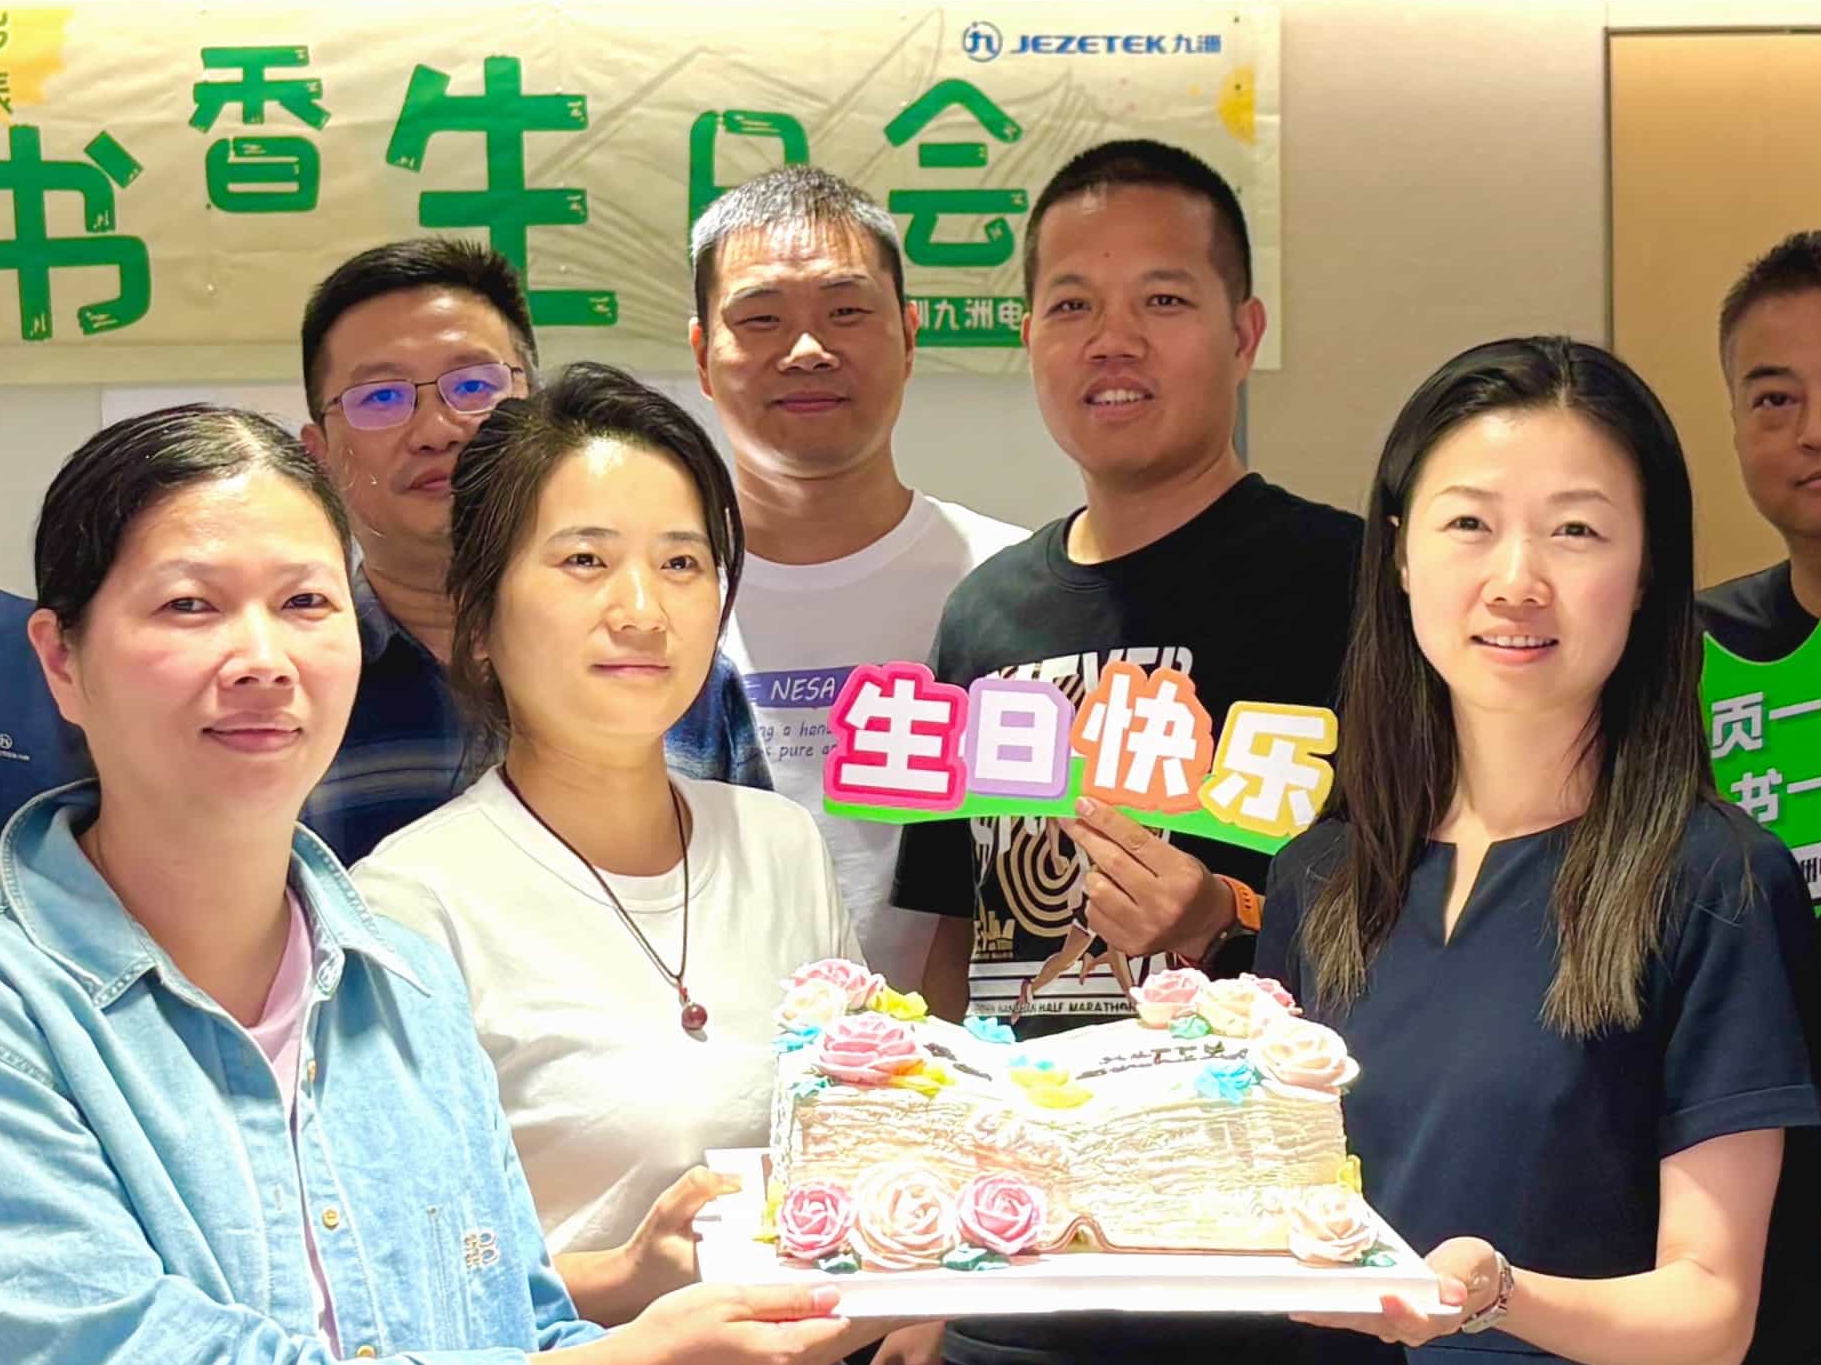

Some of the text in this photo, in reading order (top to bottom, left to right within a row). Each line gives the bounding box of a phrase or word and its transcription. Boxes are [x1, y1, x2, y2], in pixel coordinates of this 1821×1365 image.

[1010, 34, 1166, 54] JEZETEK
[839, 674, 1318, 827] 生日快乐
